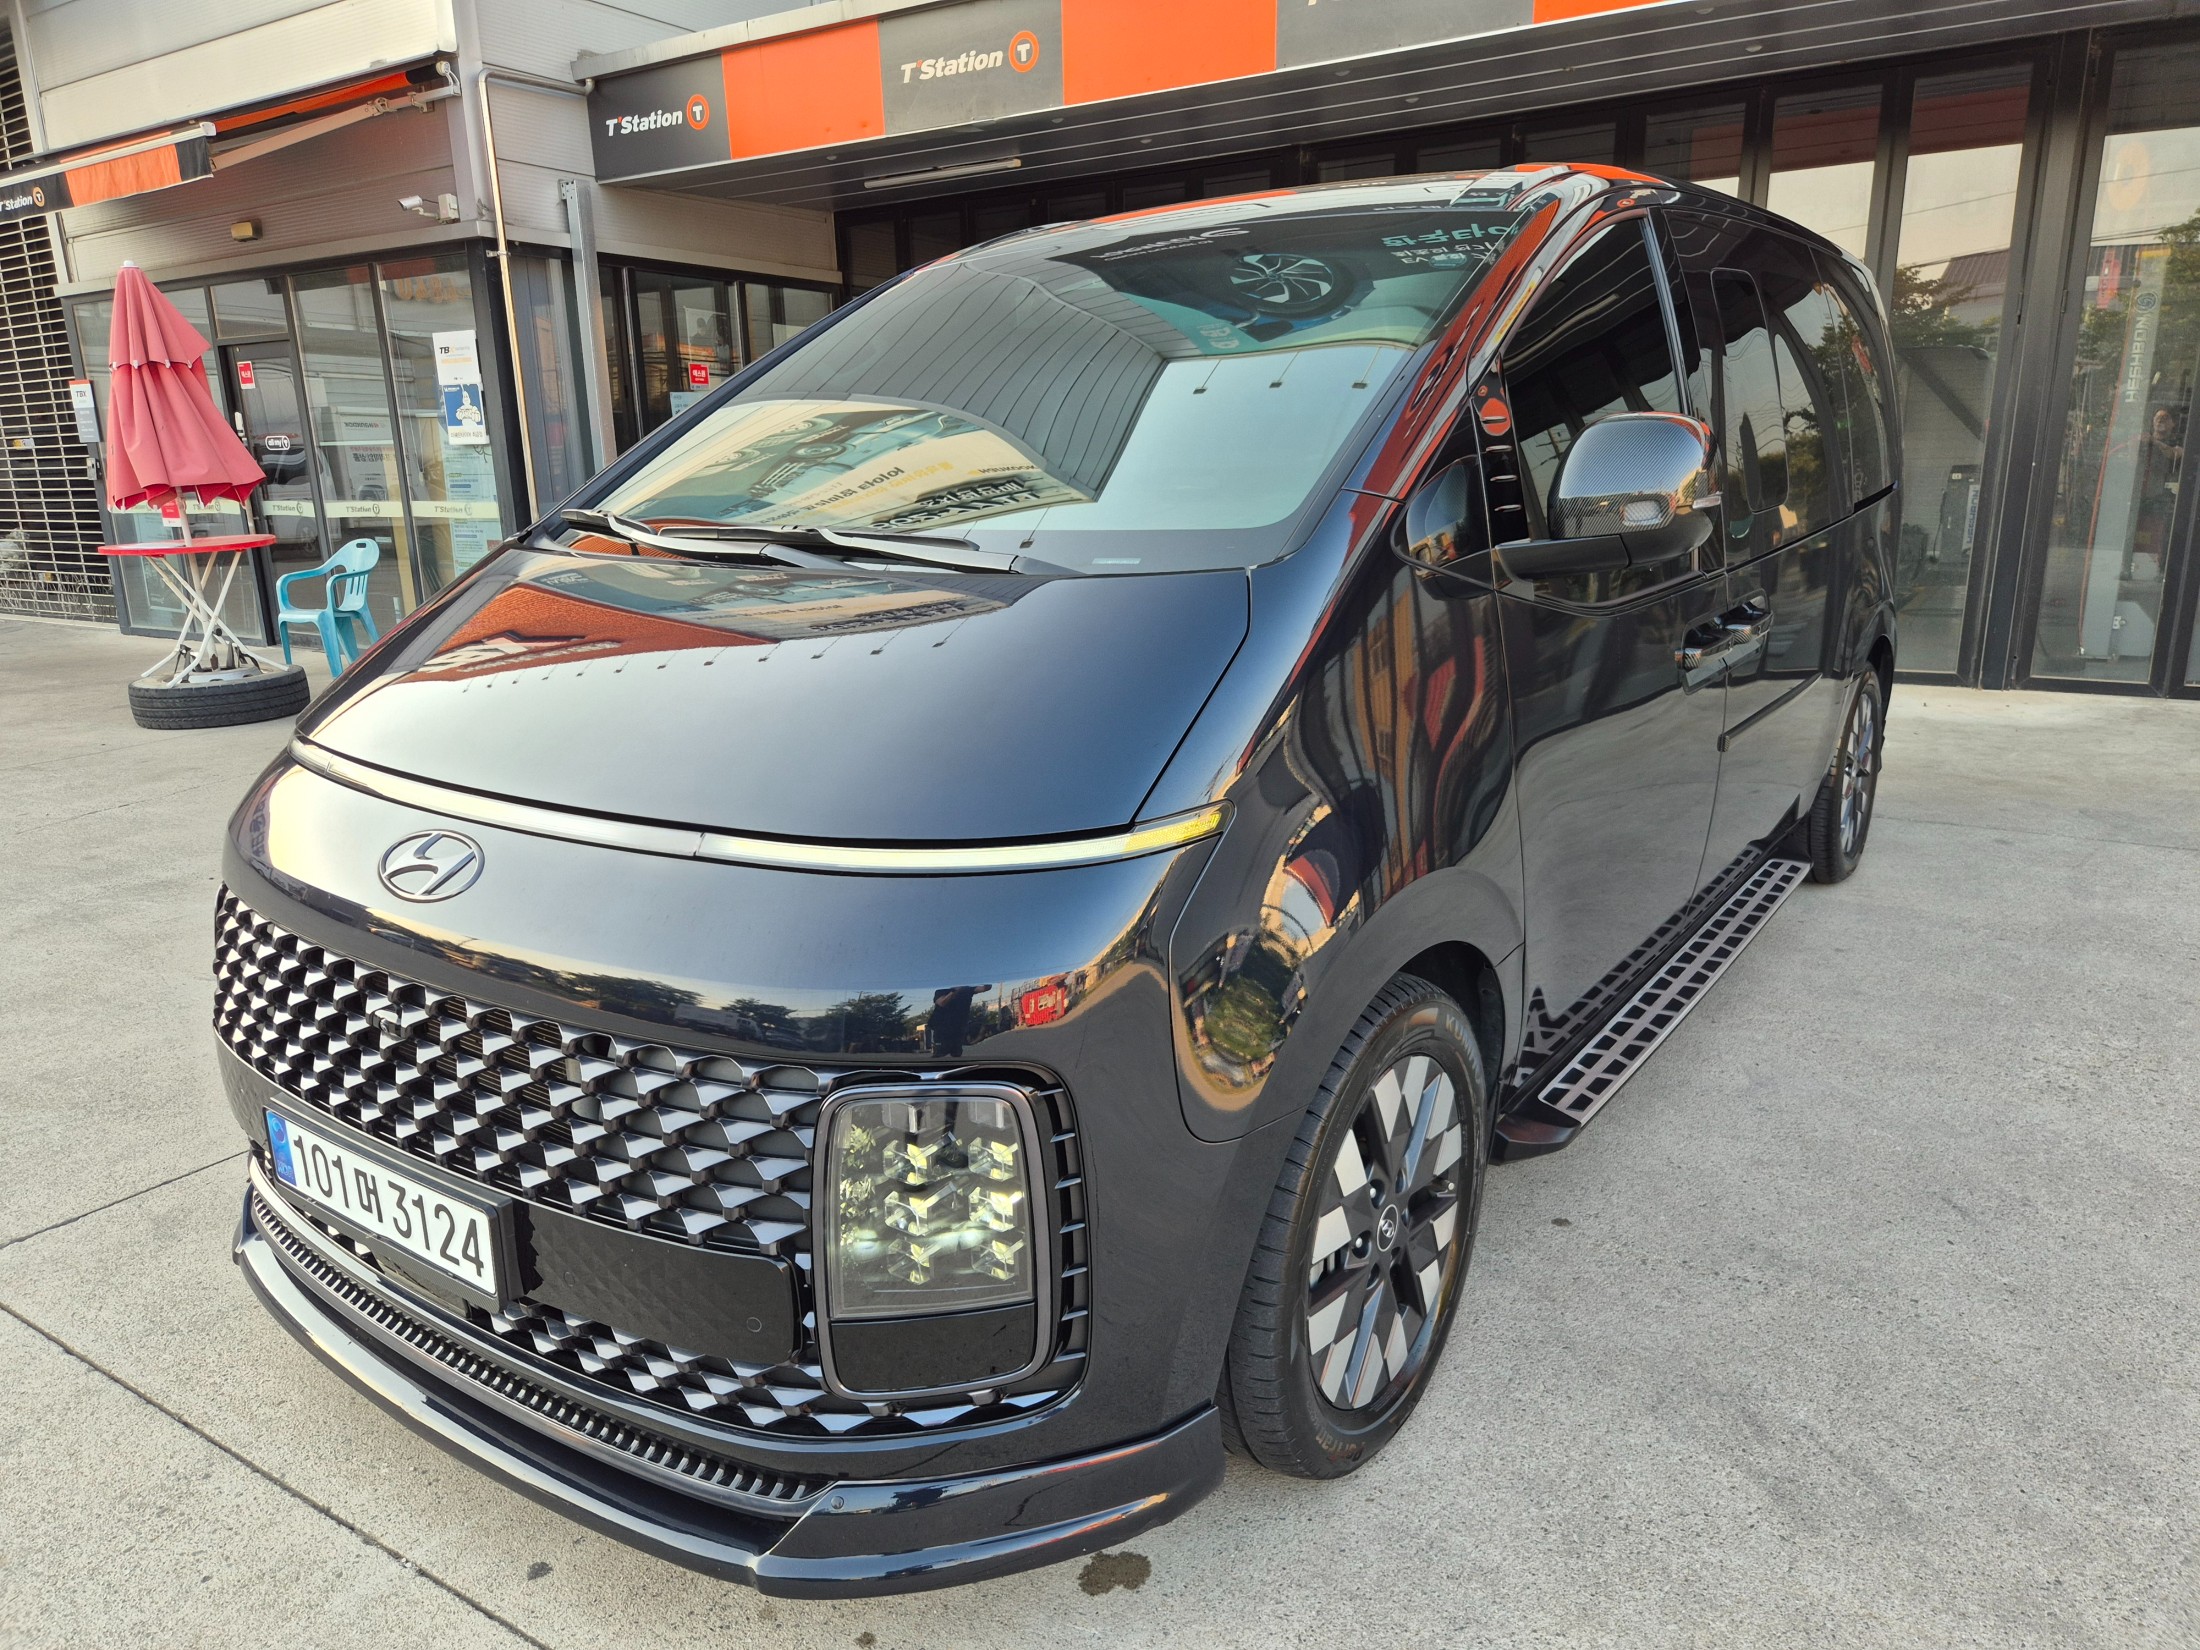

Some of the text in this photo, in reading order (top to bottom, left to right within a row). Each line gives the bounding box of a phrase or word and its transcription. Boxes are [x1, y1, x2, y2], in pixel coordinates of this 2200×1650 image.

[900, 49, 1004, 84] T'Station
[605, 109, 683, 136] T'Station
[2124, 316, 2149, 404] HESHBON
[387, 1179, 485, 1278] 3124
